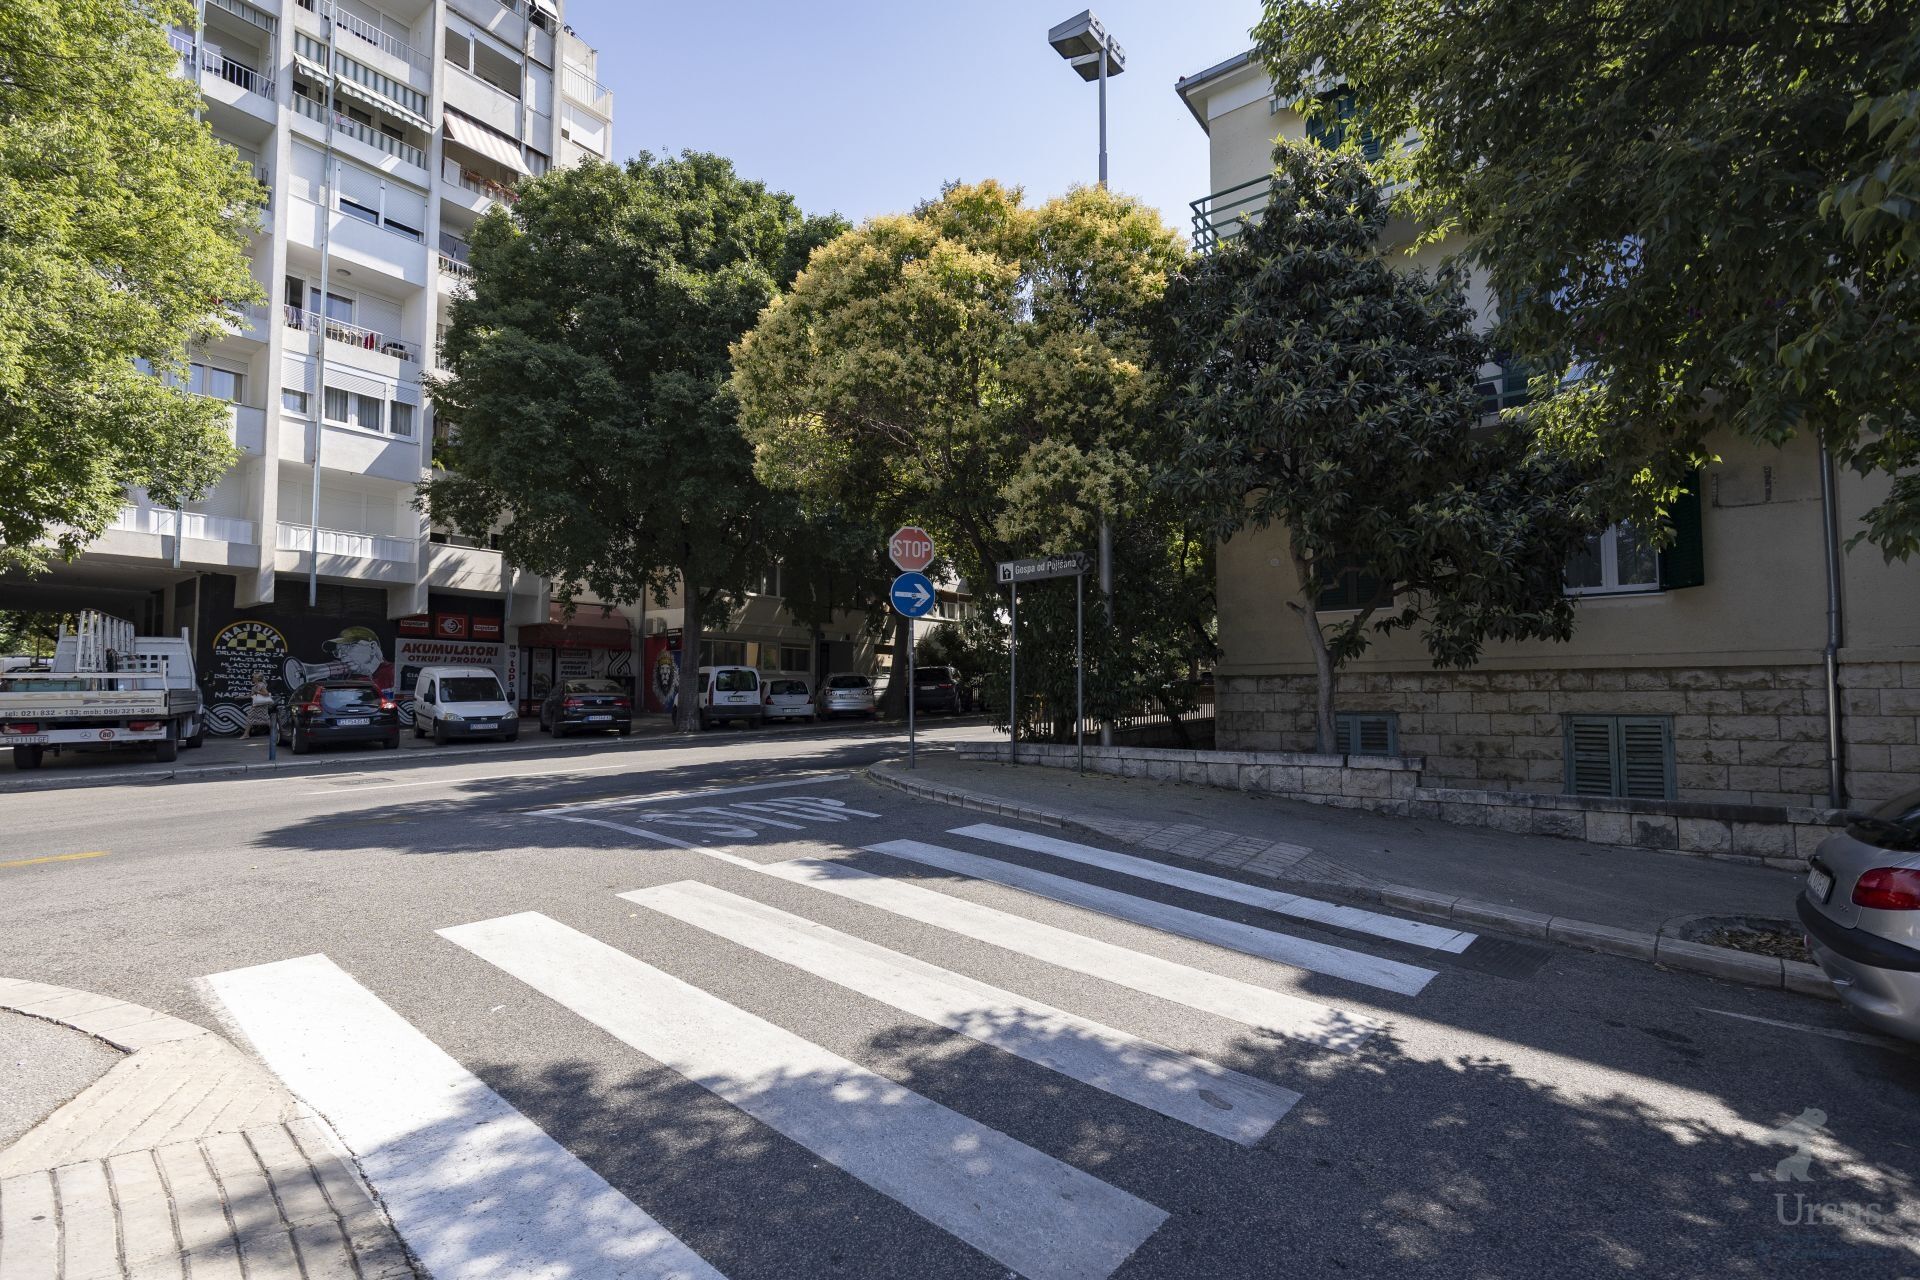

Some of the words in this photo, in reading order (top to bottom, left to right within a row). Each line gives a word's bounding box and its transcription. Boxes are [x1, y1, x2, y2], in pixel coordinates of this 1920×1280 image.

[893, 539, 931, 558] STOP
[1015, 565, 1035, 575] Gospa
[1036, 563, 1045, 571] od
[221, 623, 282, 643] HAJDUK
[401, 643, 499, 657] AKUMULATORI
[450, 656, 492, 664] PRODAJA
